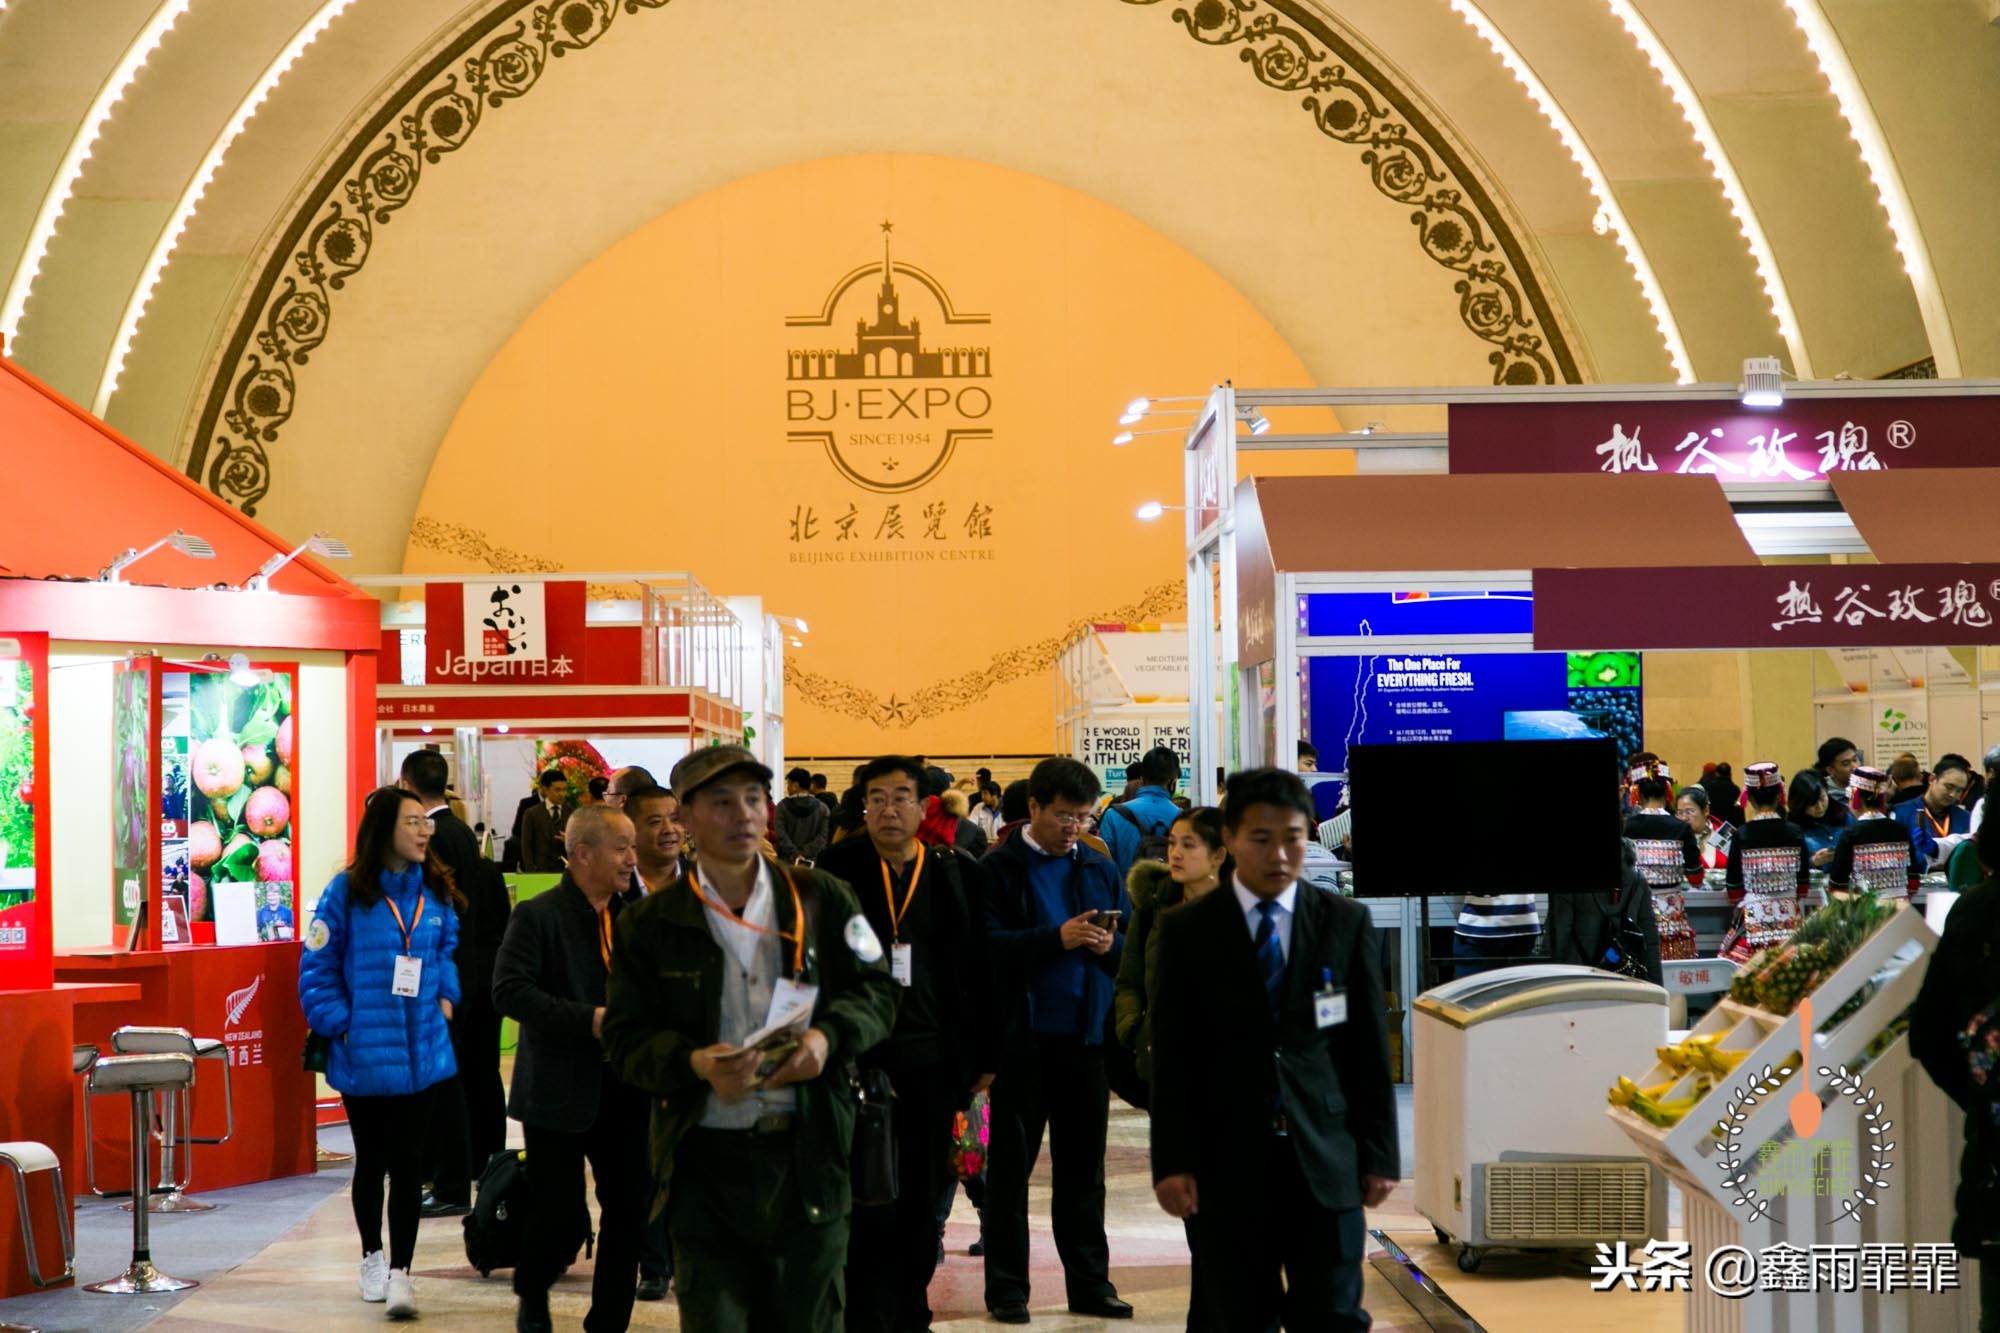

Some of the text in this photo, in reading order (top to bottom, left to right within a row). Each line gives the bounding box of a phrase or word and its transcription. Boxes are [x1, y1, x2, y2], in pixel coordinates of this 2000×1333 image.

[849, 432, 931, 446] SINCE 1954
[789, 549, 995, 565] BEIJING EXHIBITION CENTRE
[1771, 579, 1992, 631] 热谷玫瑰
[1387, 657, 1461, 671] The One Place For
[1377, 673, 1438, 688] EVERYTHING
[1103, 727, 1140, 736] WORLD
[1154, 727, 1172, 736] THE
[1096, 738, 1140, 751] FRESH
[1122, 752, 1141, 765] US
[224, 1030, 263, 1042] NEW ZEALAND
